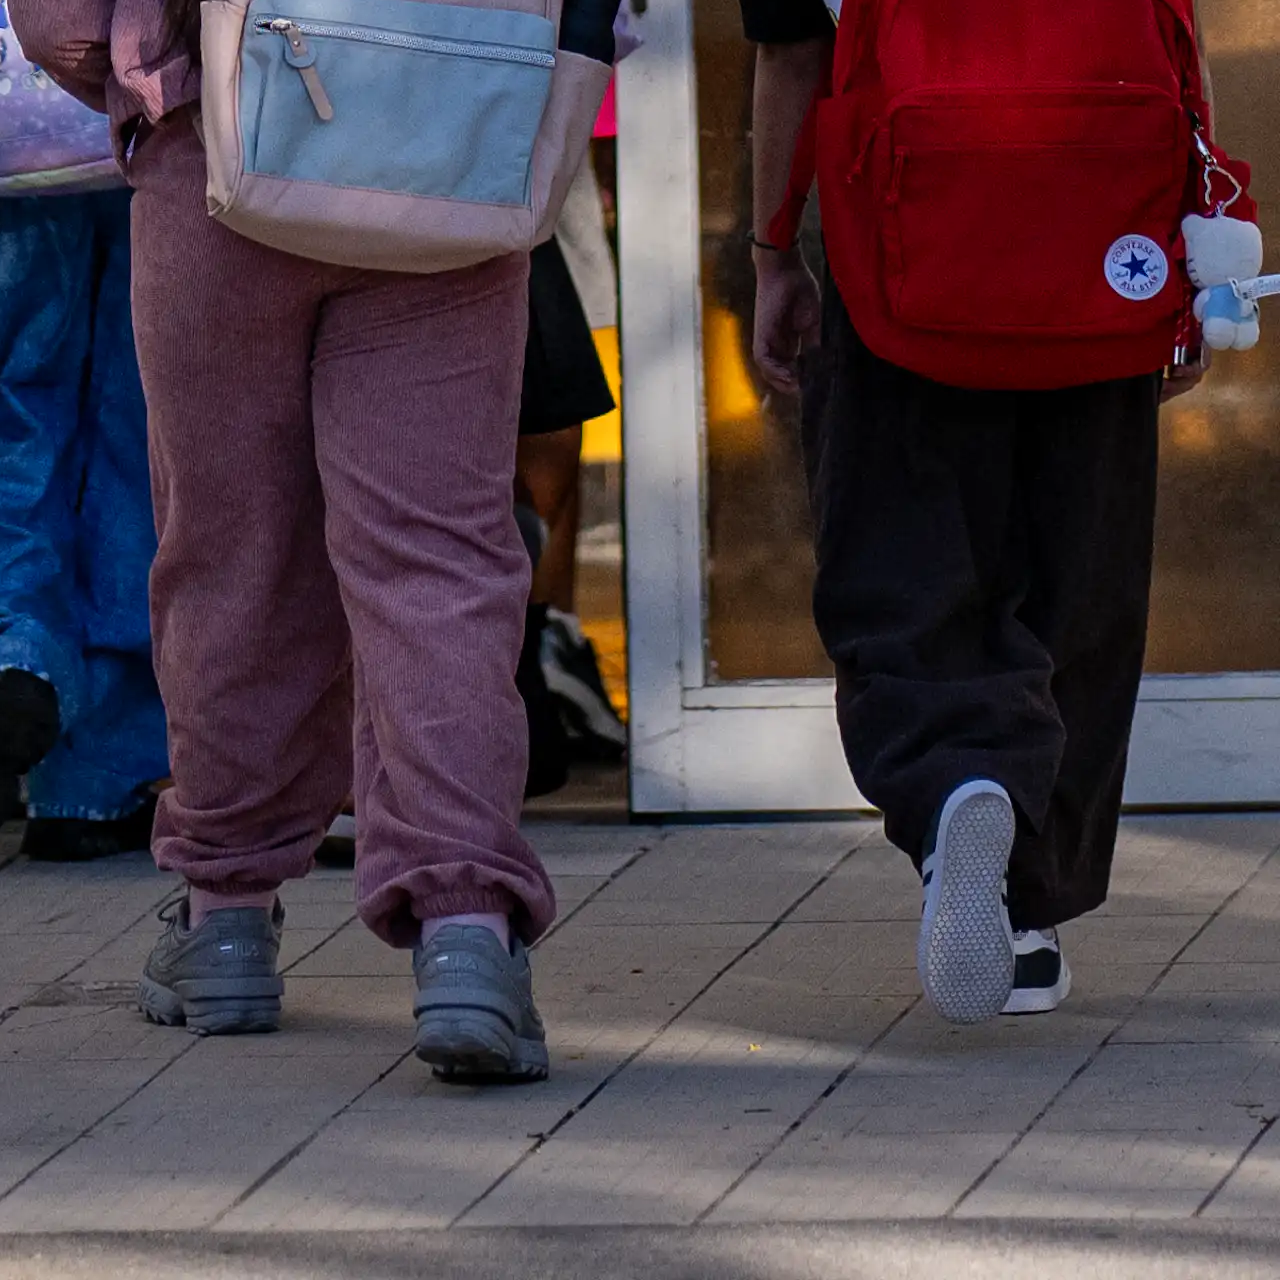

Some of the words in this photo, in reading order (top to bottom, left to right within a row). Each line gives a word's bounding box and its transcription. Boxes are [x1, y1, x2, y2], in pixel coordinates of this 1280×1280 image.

[1112, 240, 1155, 264] CONVERSE
[1120, 280, 1137, 292] ALL
[1139, 273, 1160, 292] STAR
